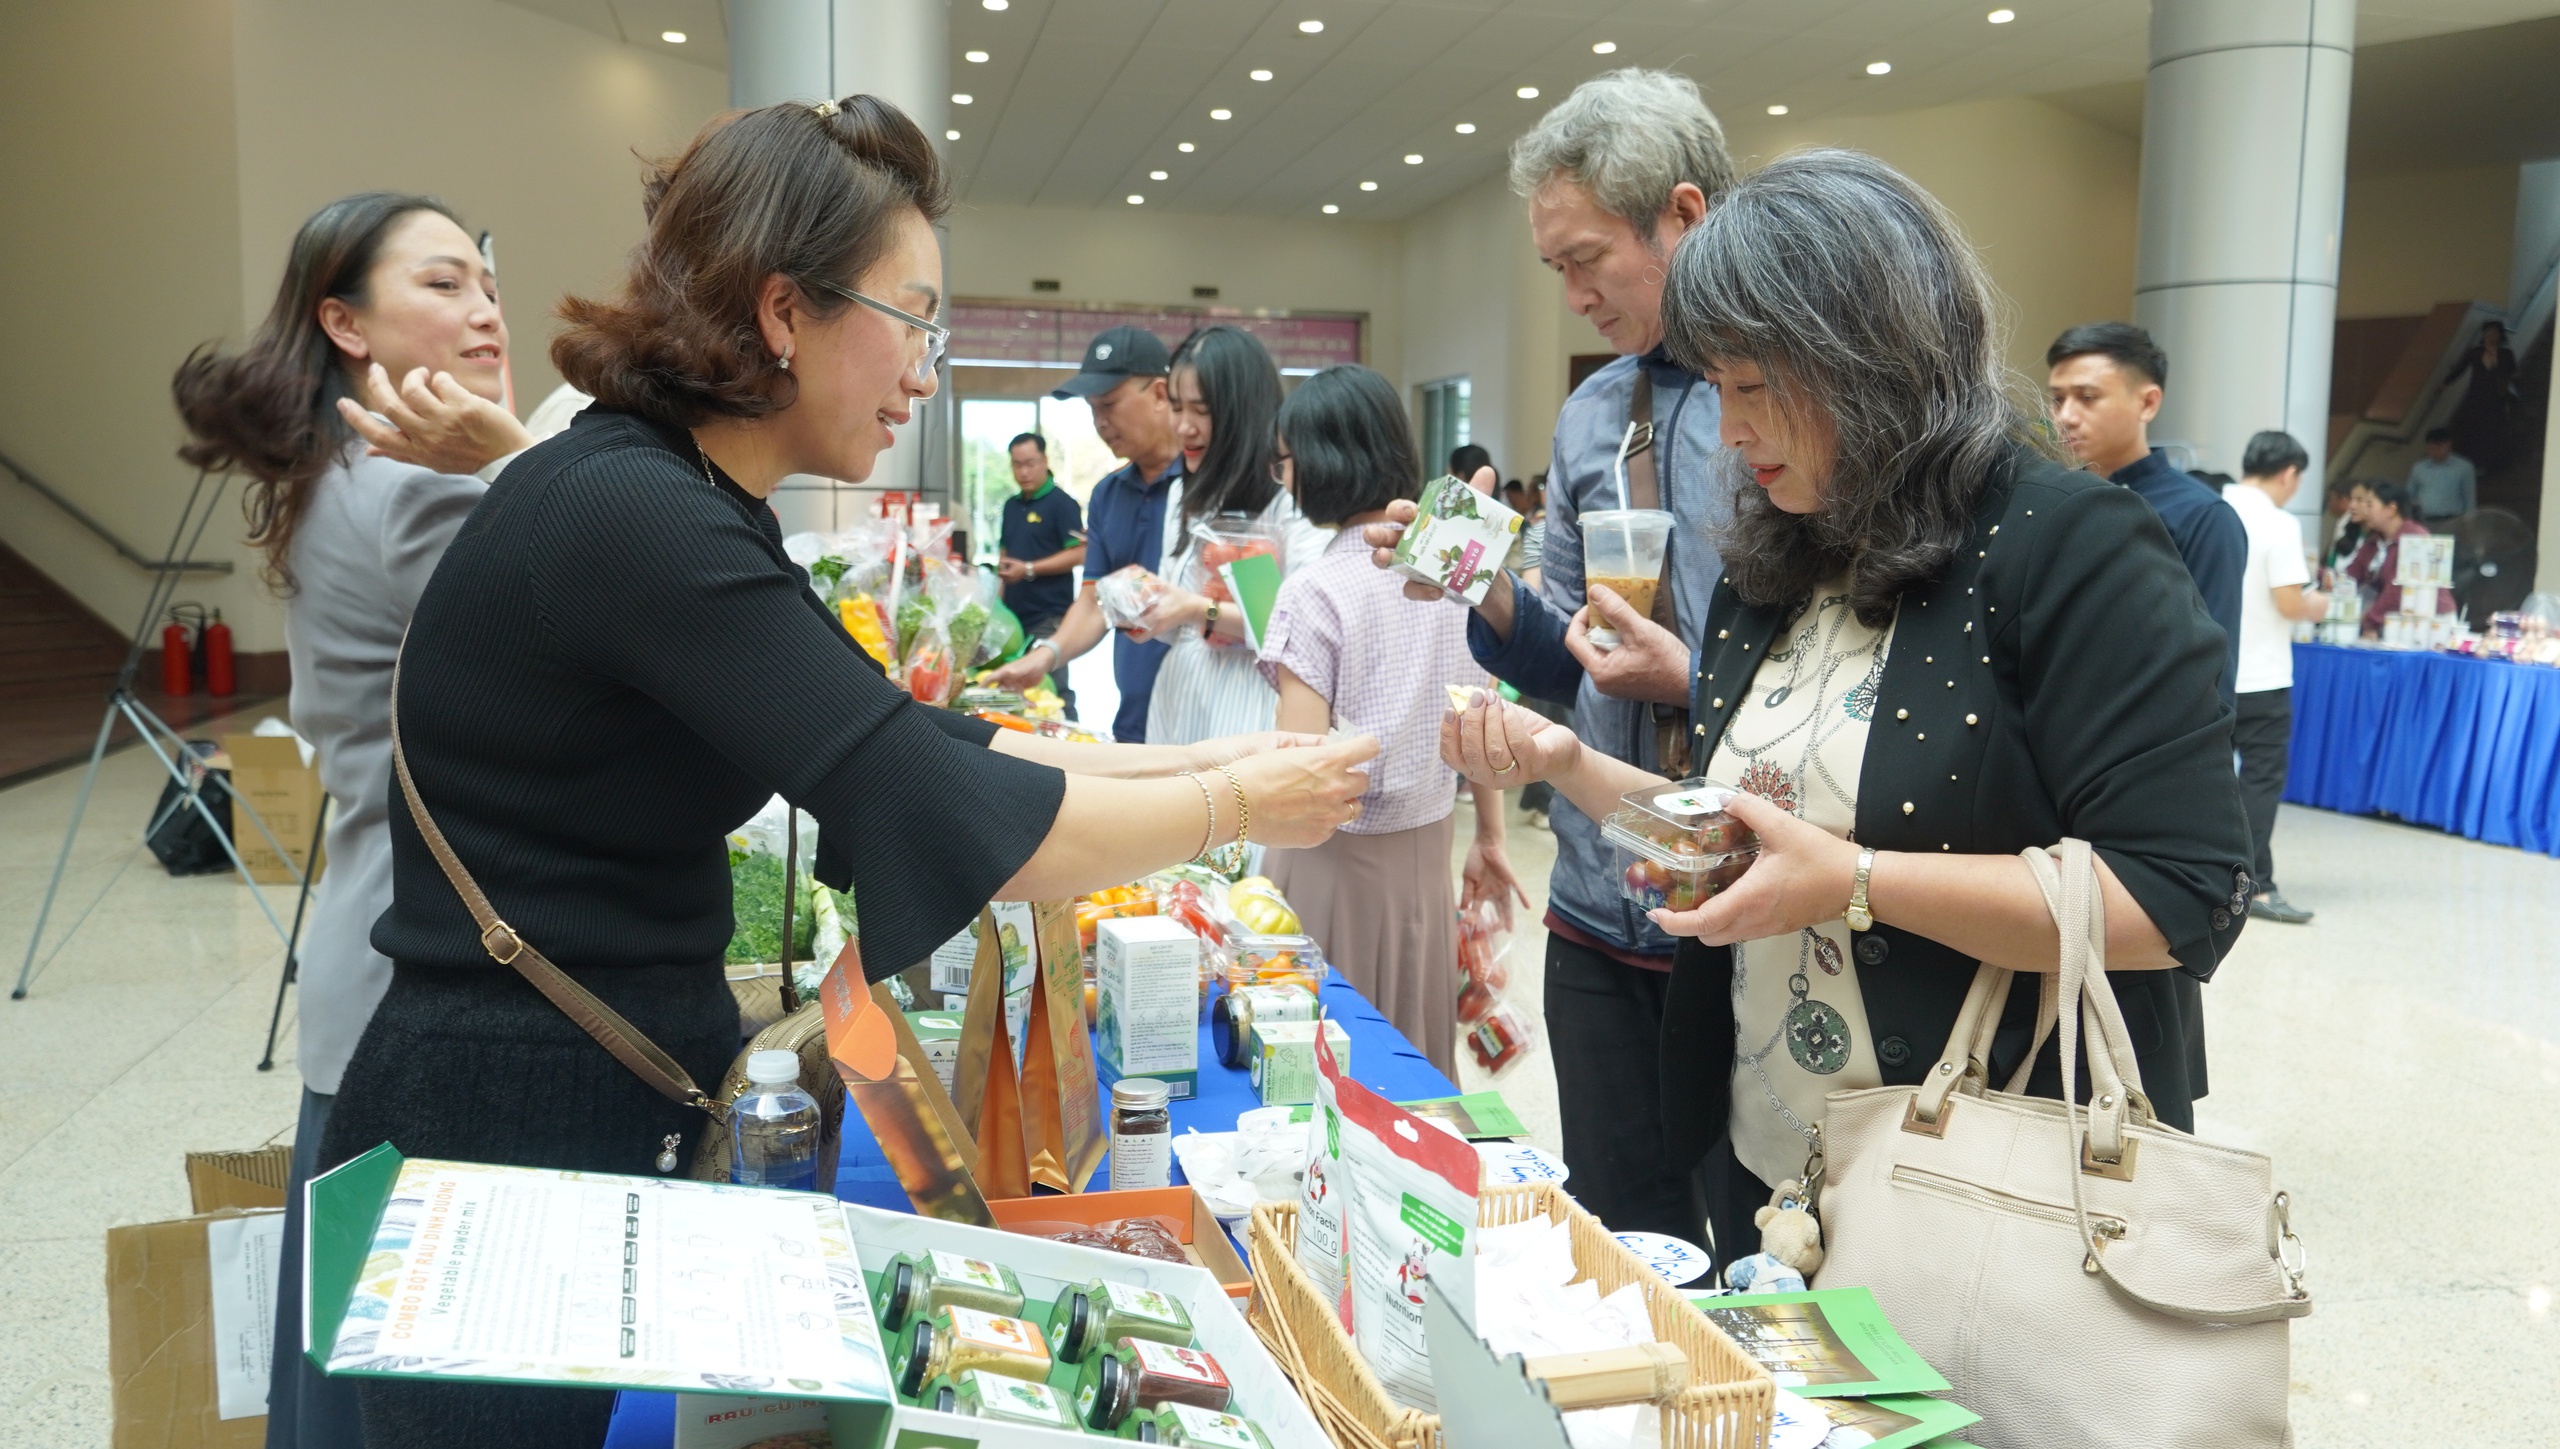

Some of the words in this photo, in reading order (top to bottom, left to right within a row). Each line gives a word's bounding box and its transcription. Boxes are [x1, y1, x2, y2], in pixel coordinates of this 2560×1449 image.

[1473, 547, 1481, 560] TÔ
[460, 1199, 478, 1217] mix
[1315, 1210, 1337, 1233] Facts
[424, 1214, 444, 1241] DINH
[451, 1219, 471, 1256] powder
[1312, 1226, 1329, 1246] 100
[1331, 1239, 1338, 1254] g
[415, 1243, 437, 1265] RAU
[429, 1258, 462, 1315] Vegetable
[392, 1295, 422, 1339] COMBO
[1385, 1291, 1422, 1325] Nutrition
[706, 1408, 755, 1425] RAU
